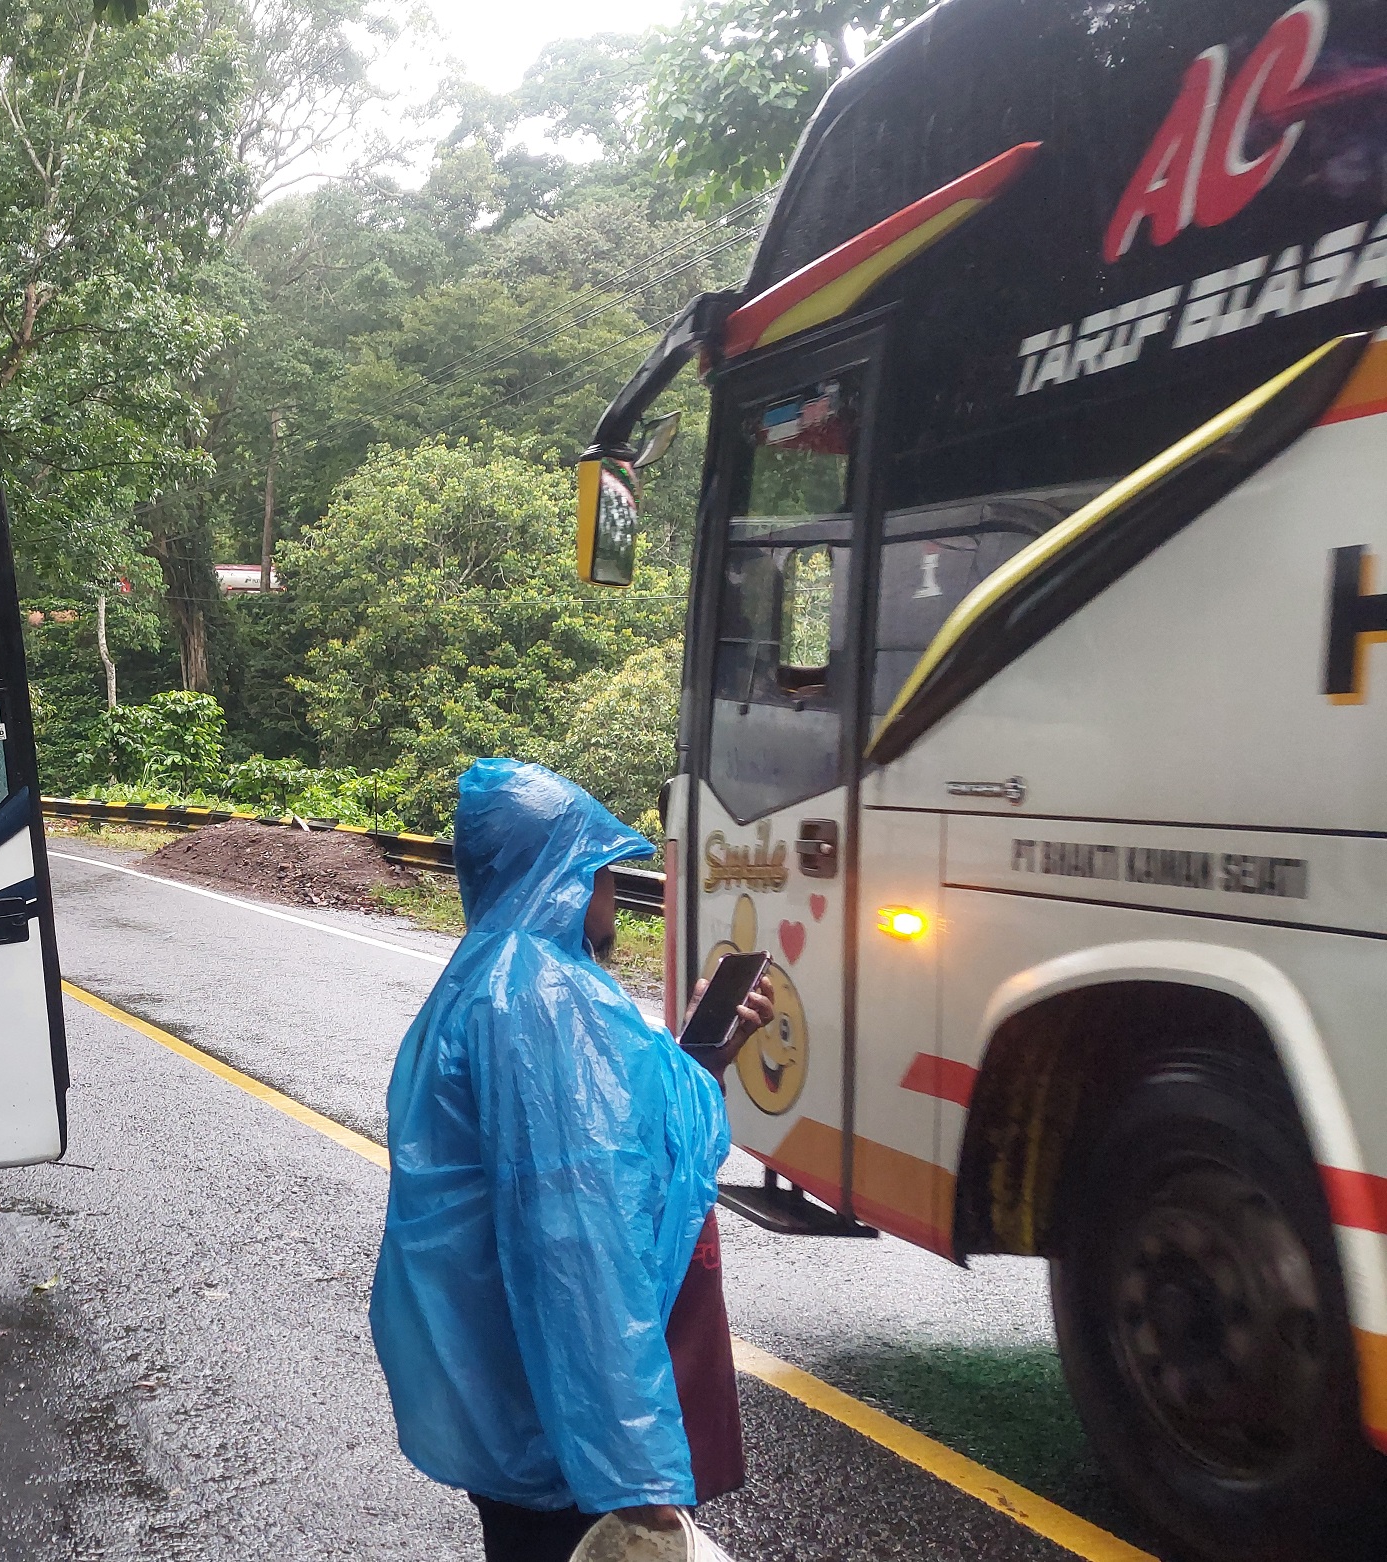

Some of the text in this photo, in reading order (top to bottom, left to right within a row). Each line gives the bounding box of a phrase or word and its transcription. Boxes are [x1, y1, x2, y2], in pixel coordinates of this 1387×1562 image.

[1102, 0, 1330, 264] AC
[1015, 284, 1184, 396] TARIF
[703, 818, 789, 894] Smile
